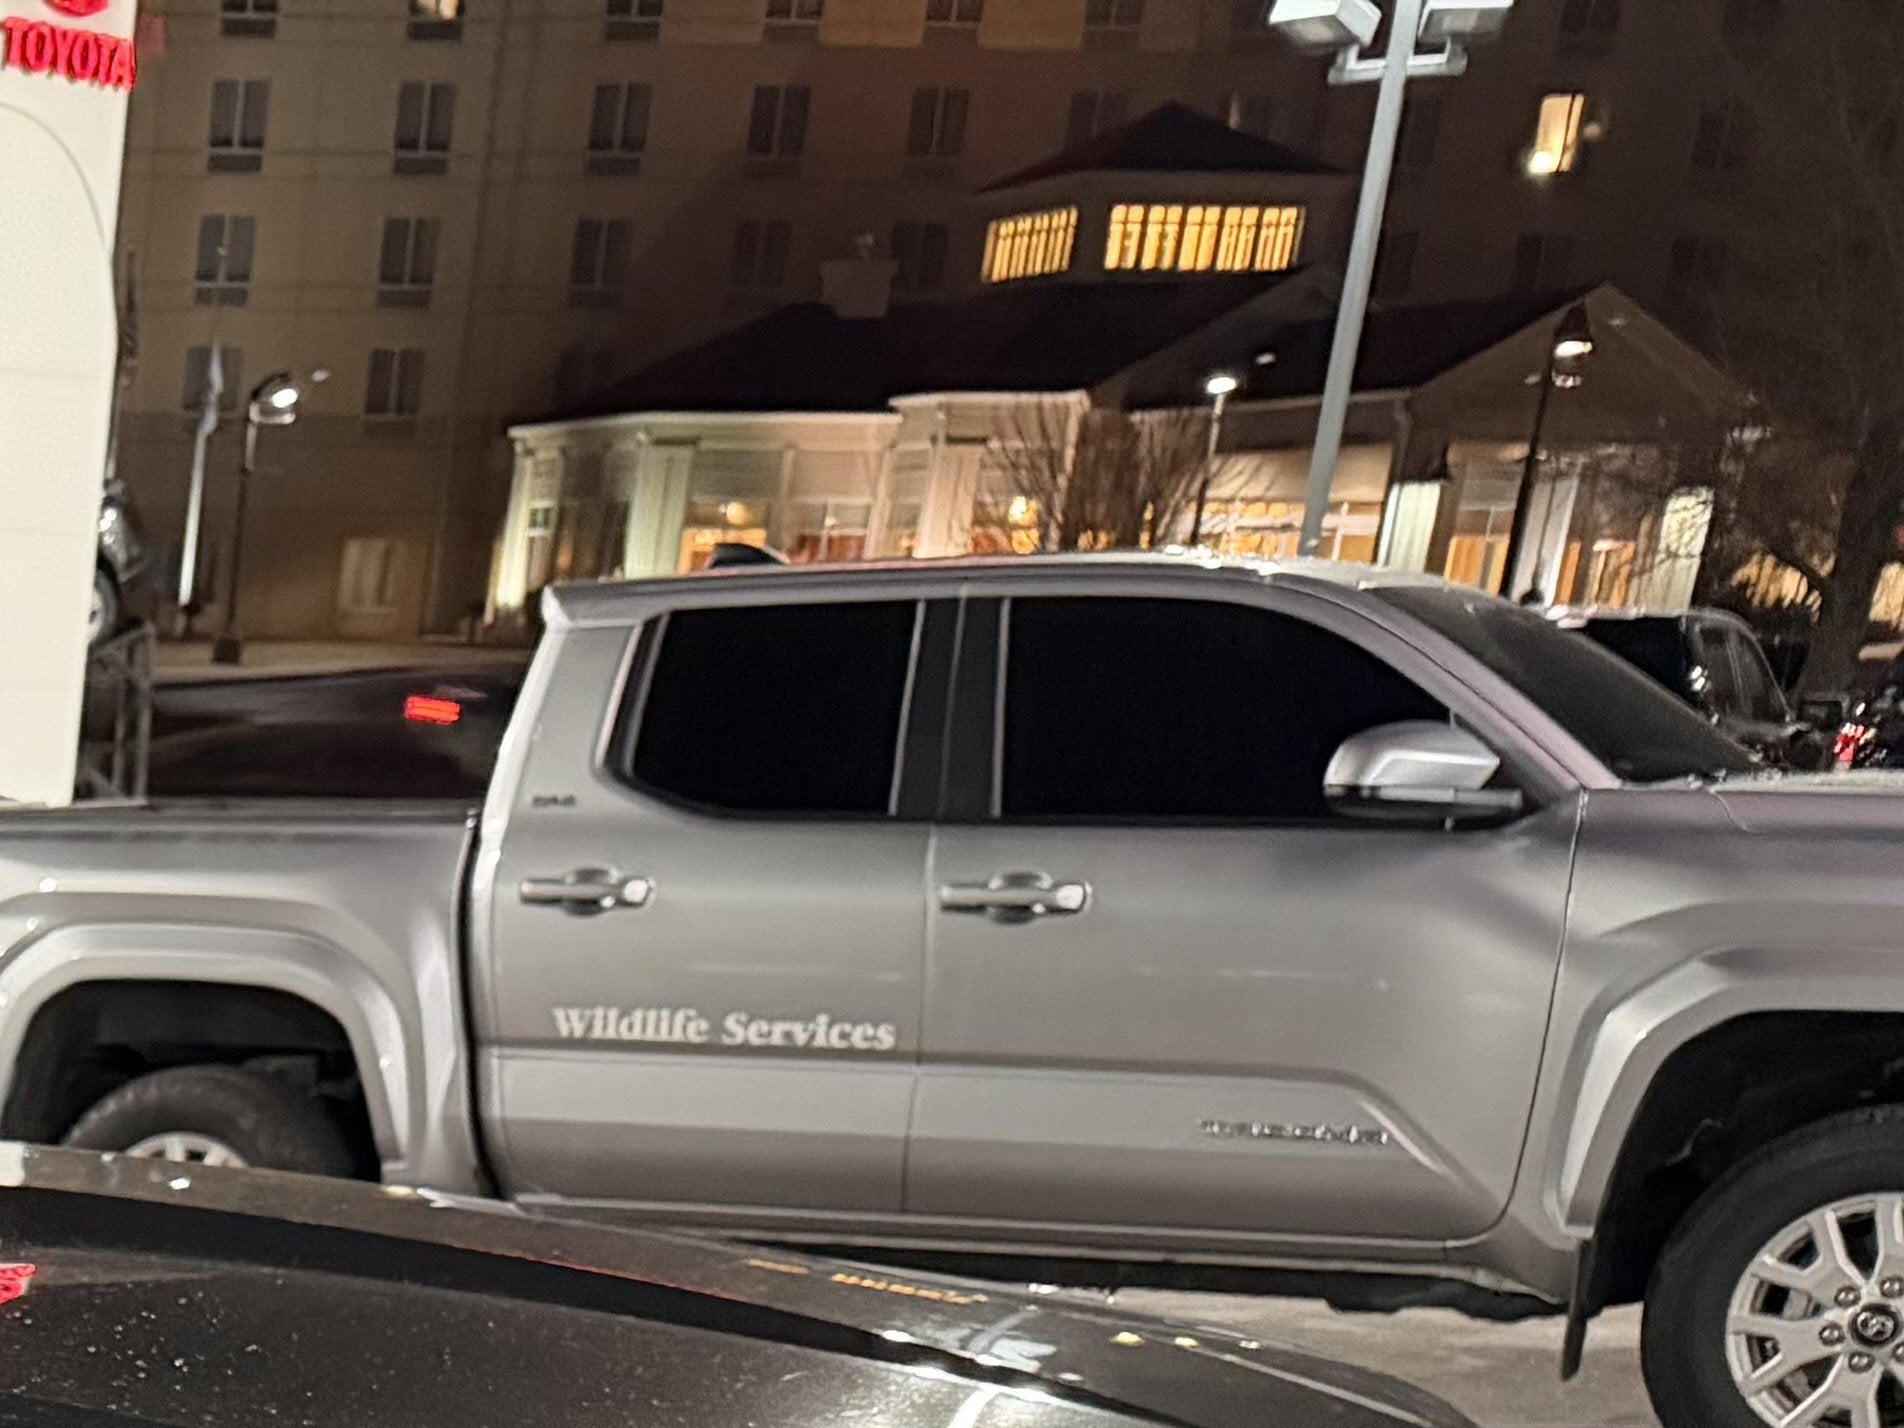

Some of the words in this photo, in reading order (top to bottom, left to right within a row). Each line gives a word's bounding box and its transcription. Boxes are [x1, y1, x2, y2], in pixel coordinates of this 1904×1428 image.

[0, 16, 136, 92] TOYOTA
[551, 1005, 711, 1044] Wildlife
[720, 1011, 897, 1051] Services
